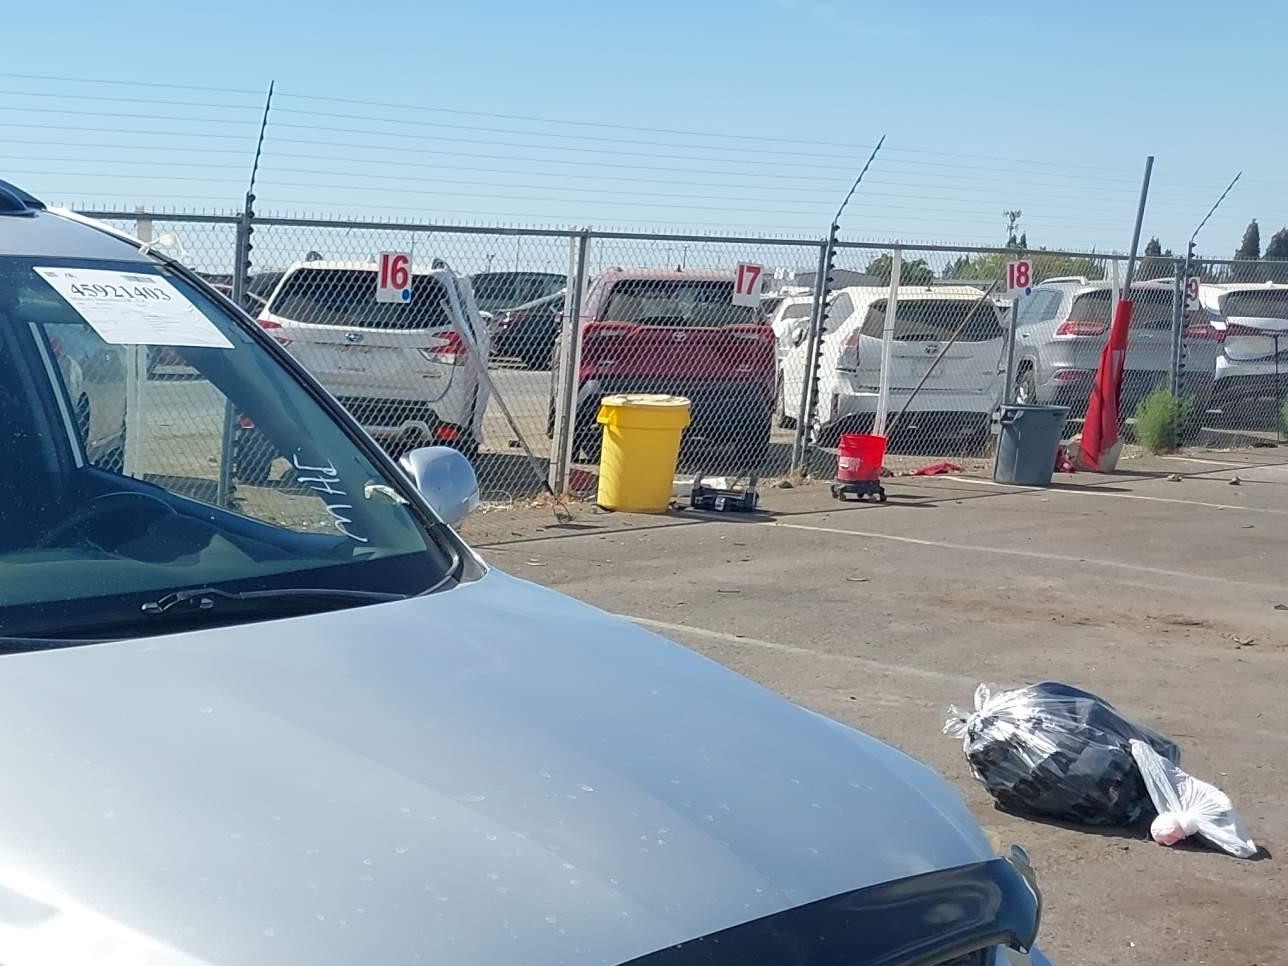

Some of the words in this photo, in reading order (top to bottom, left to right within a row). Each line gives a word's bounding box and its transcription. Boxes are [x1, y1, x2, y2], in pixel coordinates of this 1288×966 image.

[380, 254, 409, 290] 16
[736, 264, 761, 296] 17
[1009, 261, 1030, 289] 18
[71, 283, 172, 301] 45921403
